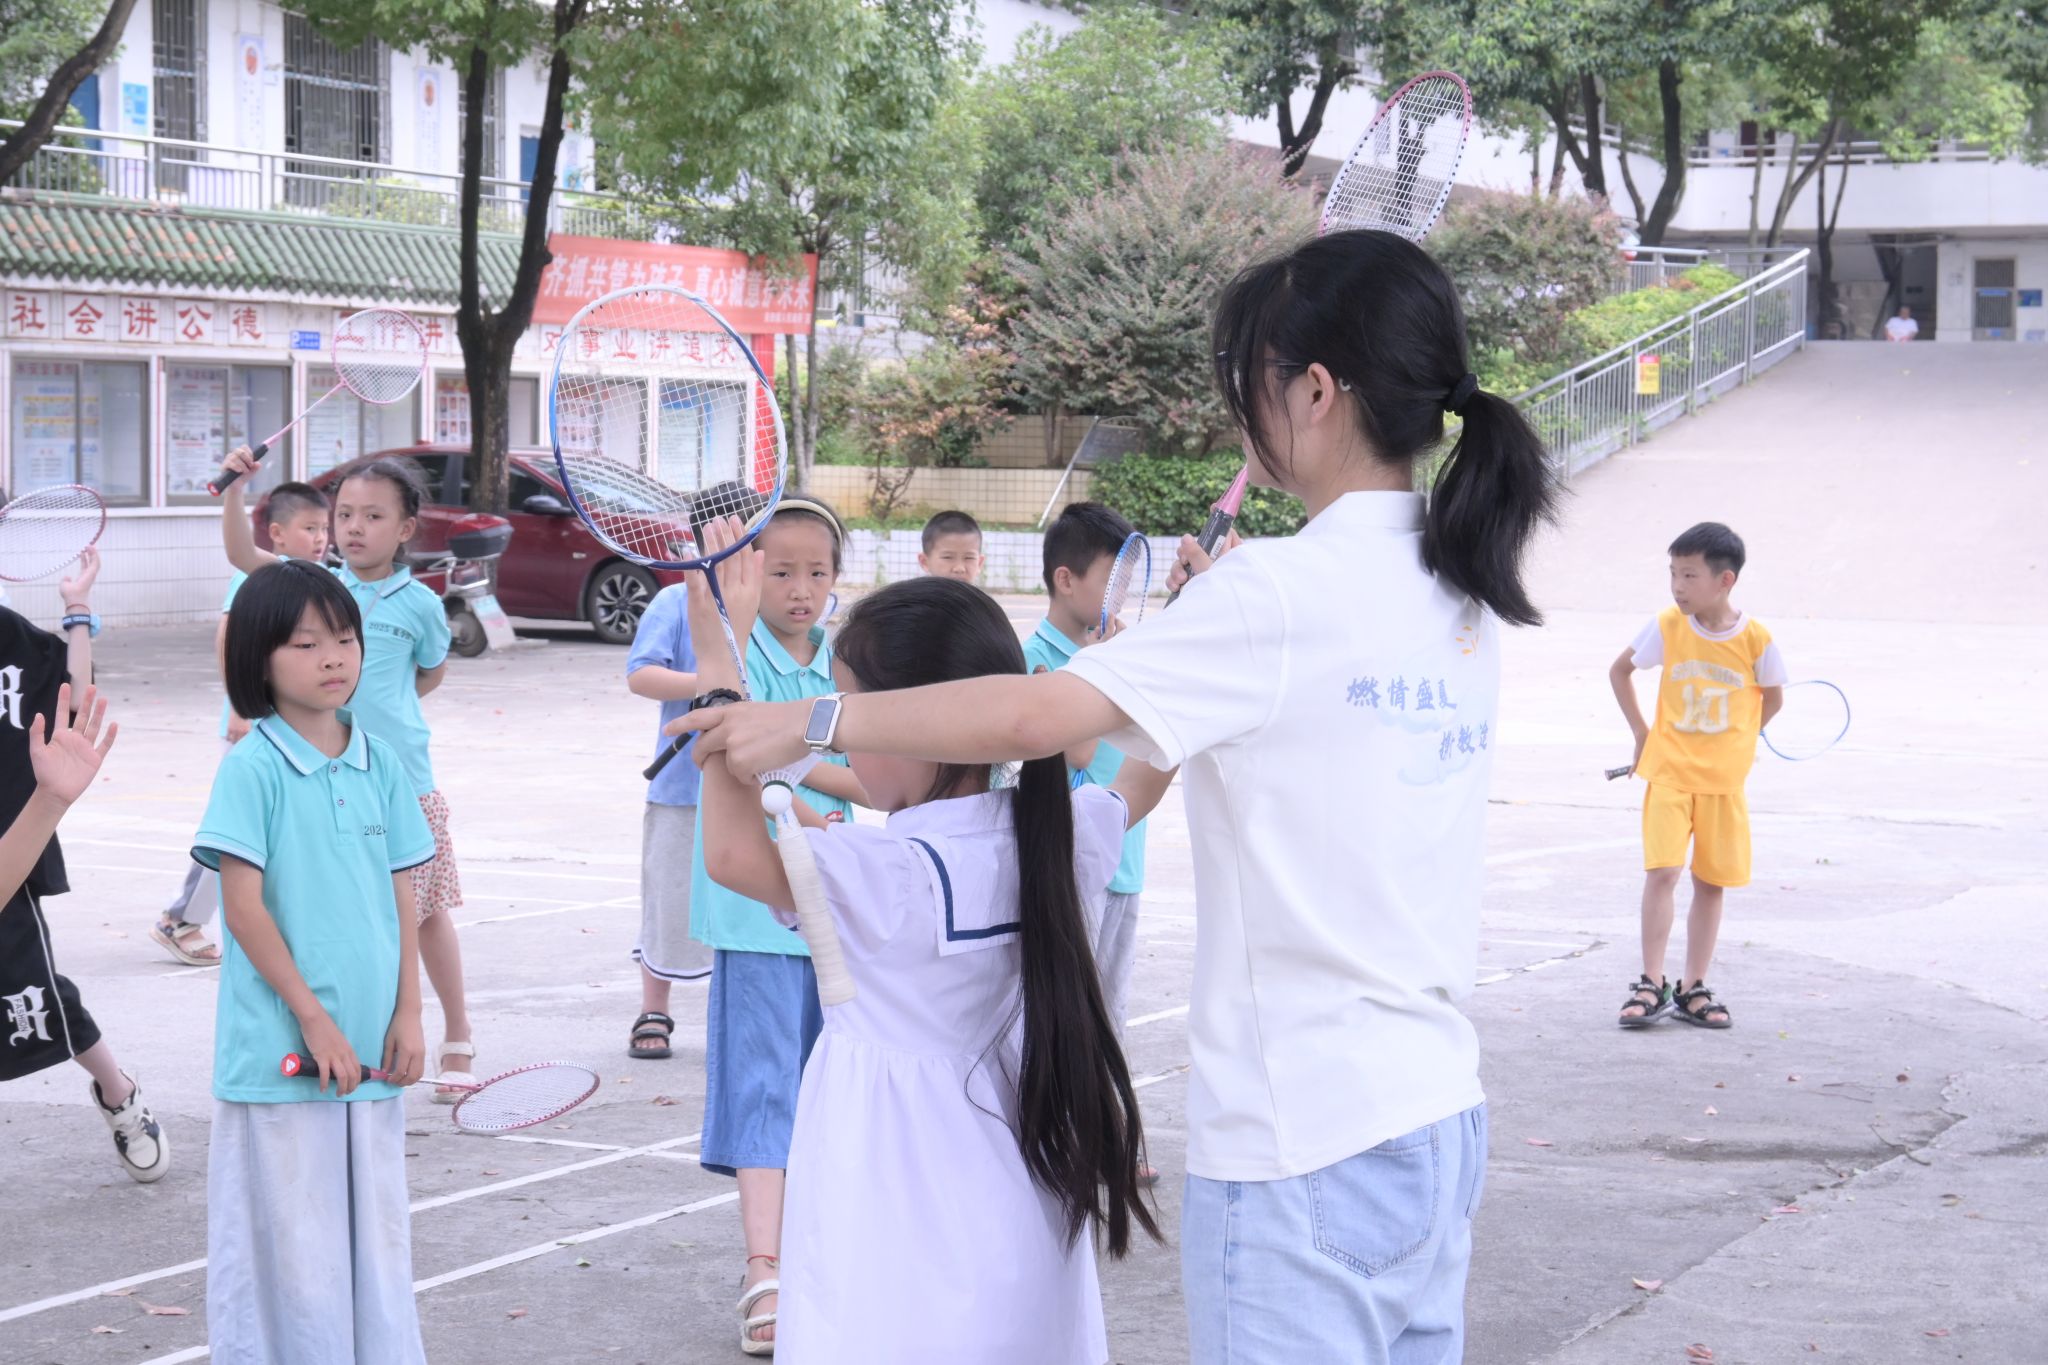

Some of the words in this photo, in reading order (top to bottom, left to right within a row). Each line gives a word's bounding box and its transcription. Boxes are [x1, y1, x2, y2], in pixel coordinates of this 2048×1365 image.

[10, 295, 262, 341] 社会讲公德
[1674, 683, 1729, 734] 10
[13, 997, 29, 1033] FASHION
